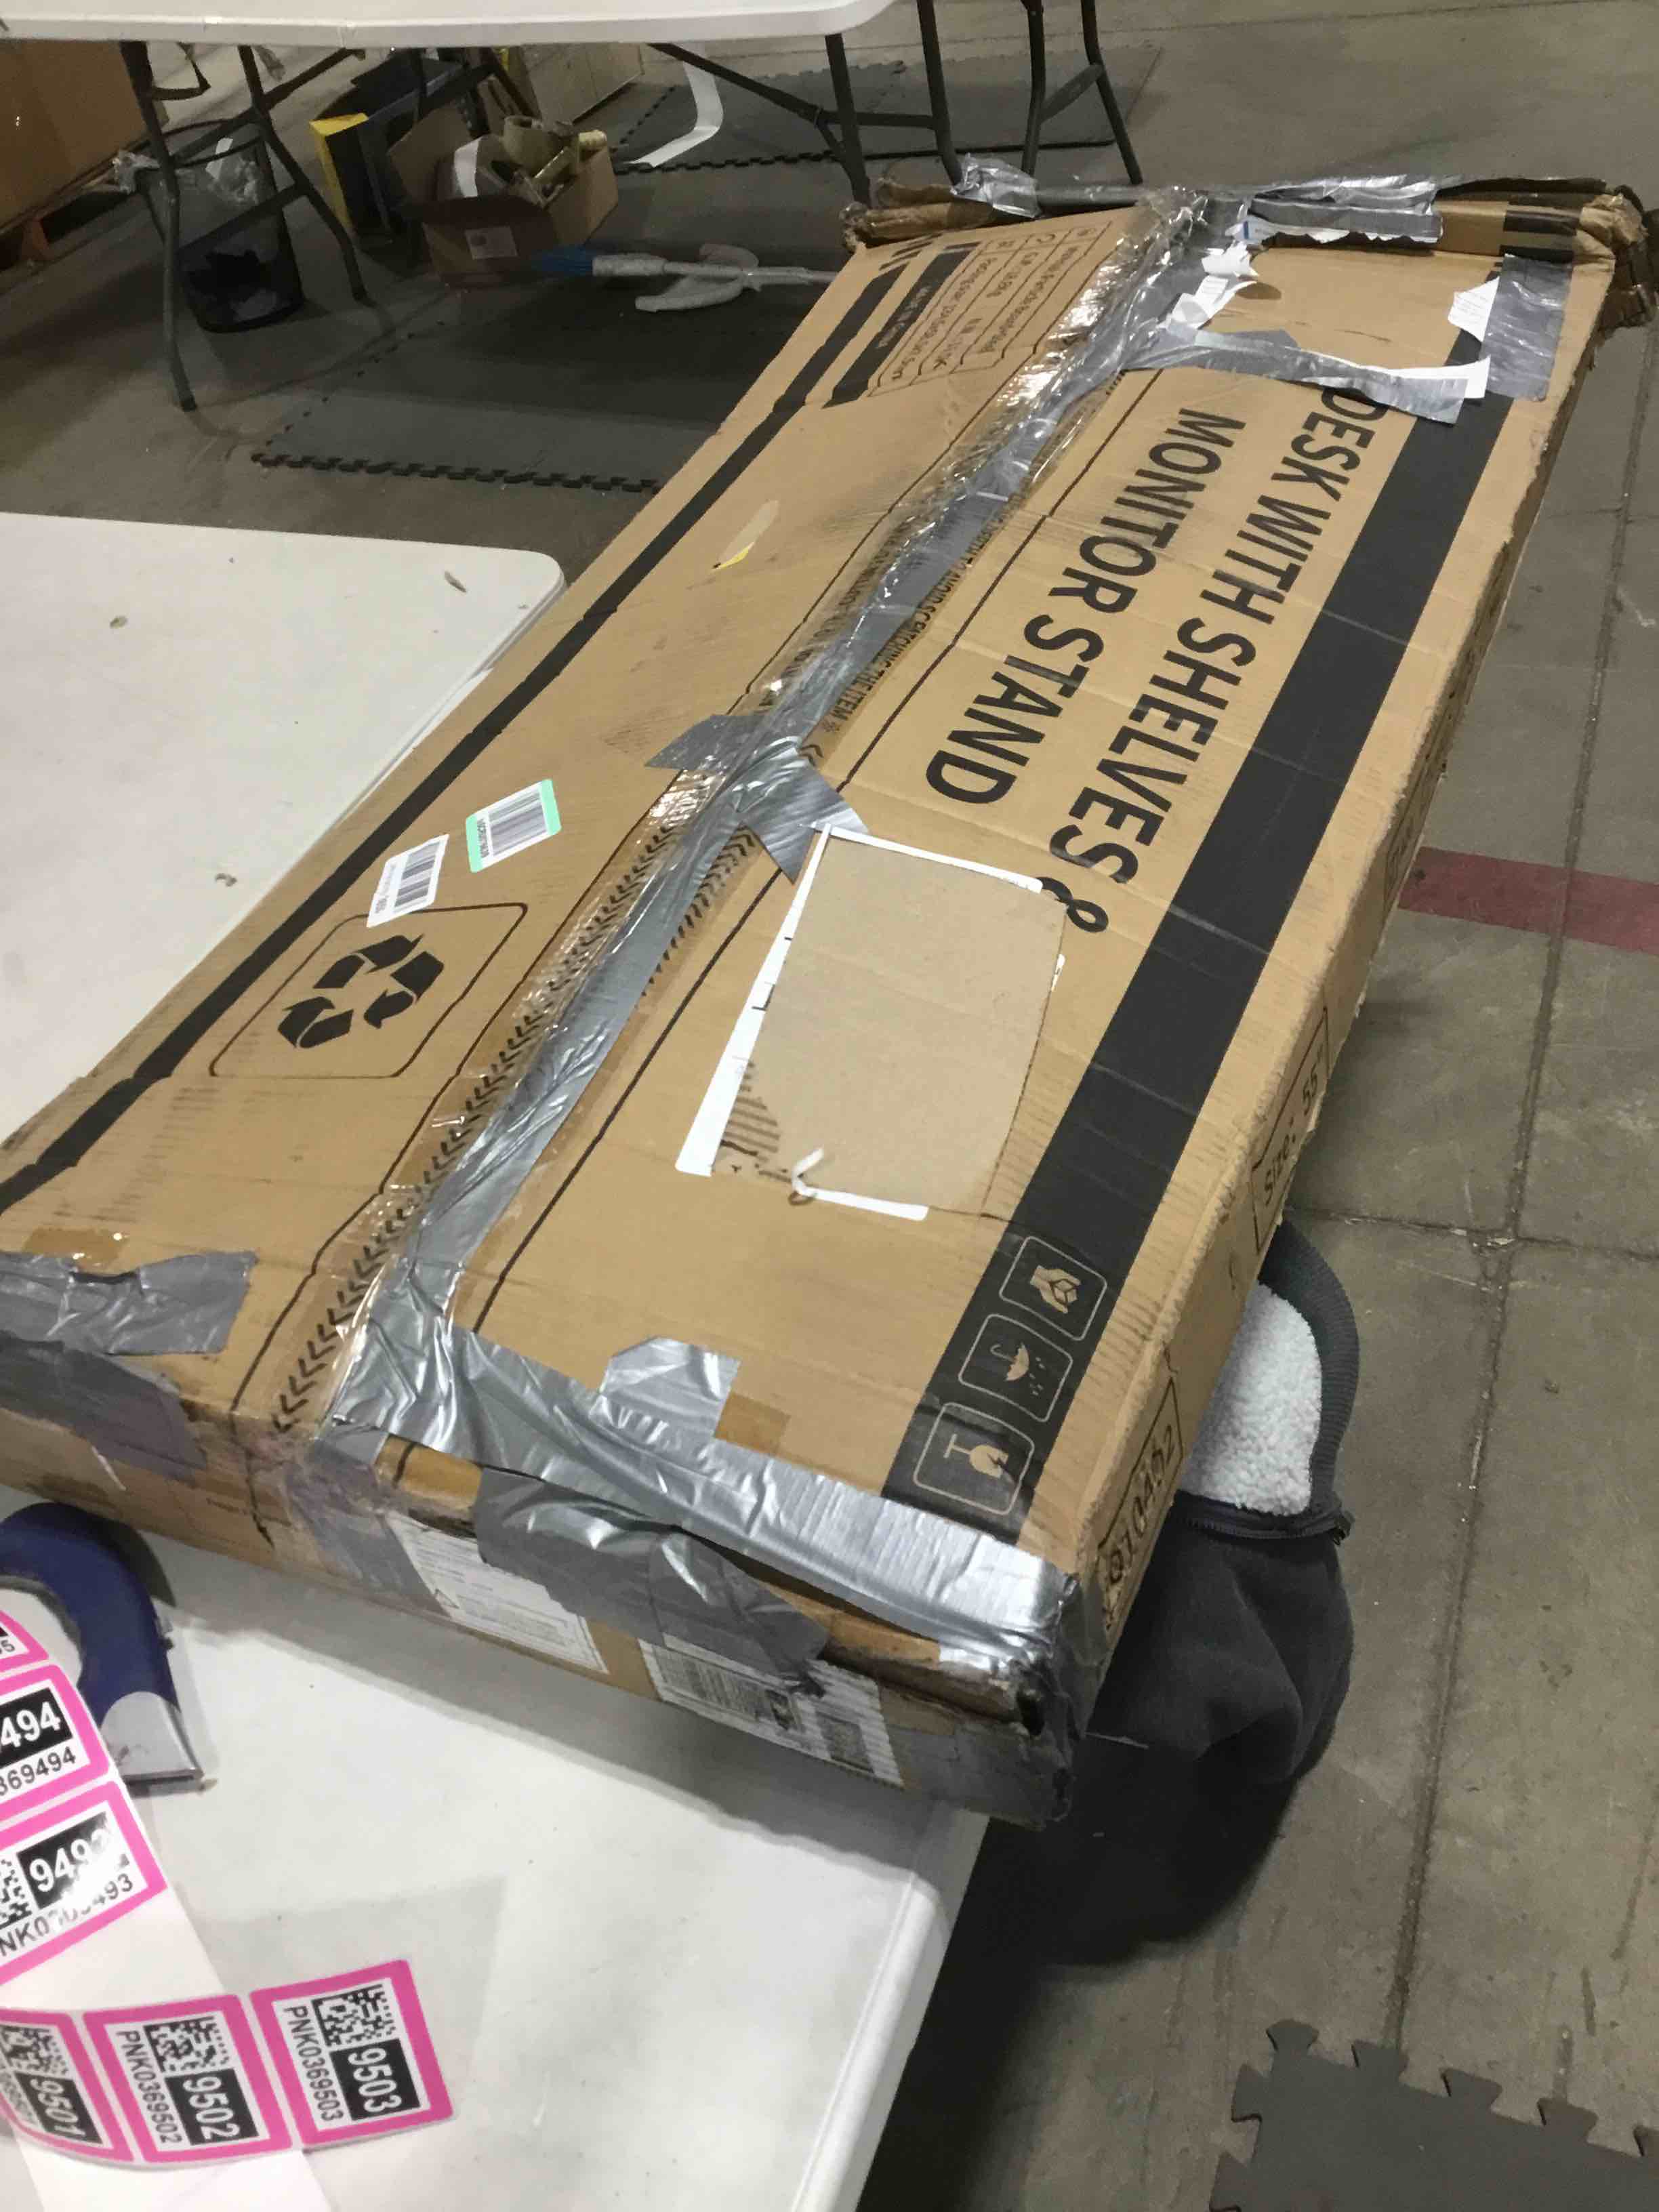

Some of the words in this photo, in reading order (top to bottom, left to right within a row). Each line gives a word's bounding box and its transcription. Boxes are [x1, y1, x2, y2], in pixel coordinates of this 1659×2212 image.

[1270, 387, 1390, 502] DESK
[1048, 408, 1247, 614] MONITOR
[1199, 495, 1332, 625] WITH
[924, 615, 1105, 804] STAND
[1048, 617, 1258, 885] SHELVES
[1035, 876, 1109, 933] &
[0, 1701, 62, 1748] 494
[30, 2078, 86, 2136] 9501
[115, 2029, 184, 2144] PNK0369502
[182, 2075, 241, 2140] 9502
[283, 2005, 344, 2122] PNK0369503
[347, 2047, 403, 2113] 9503
